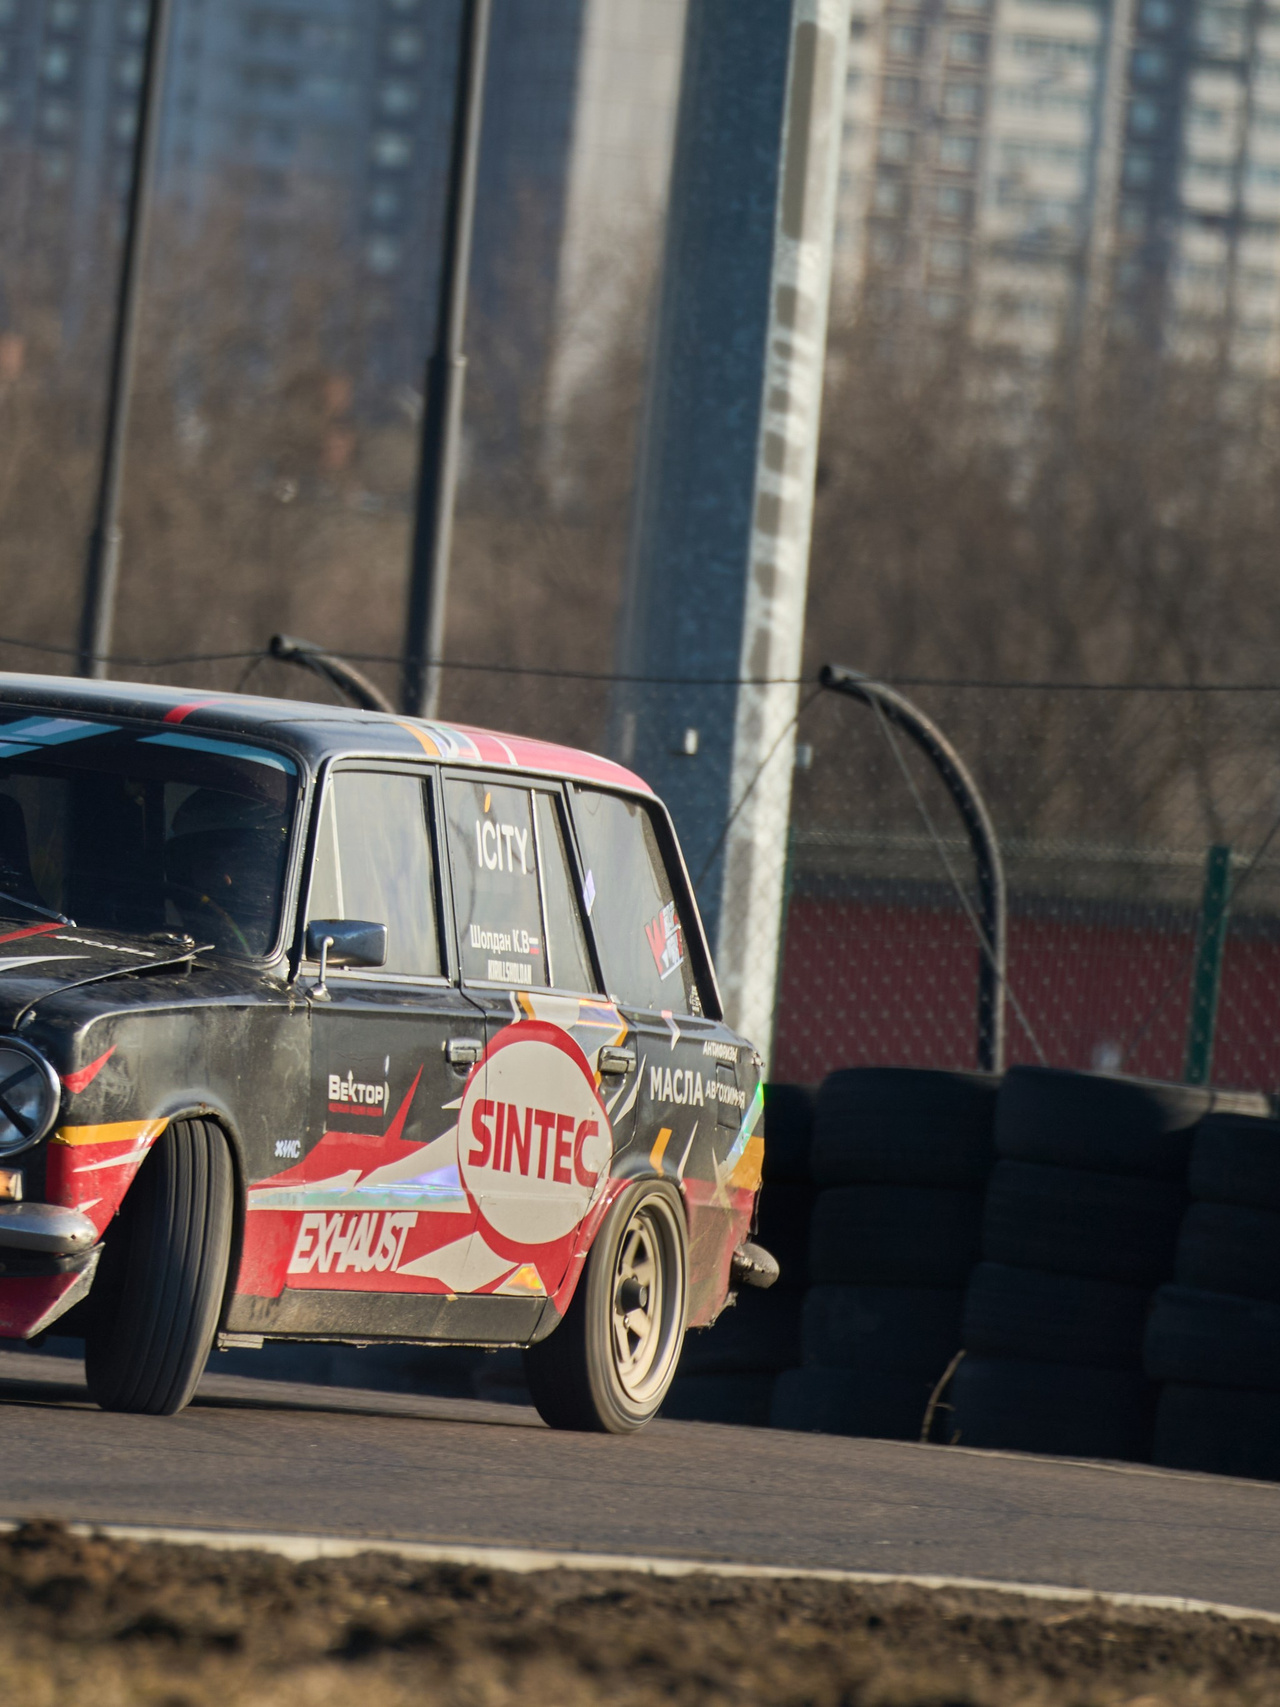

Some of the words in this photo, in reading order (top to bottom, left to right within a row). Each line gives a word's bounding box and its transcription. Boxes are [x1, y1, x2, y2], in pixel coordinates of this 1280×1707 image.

[476, 819, 528, 875] ICITY
[470, 924, 511, 955] Шолдан
[650, 1065, 704, 1108] МАСЛА
[467, 1097, 600, 1188] SINTEC
[287, 1211, 419, 1274] EXHAUST
